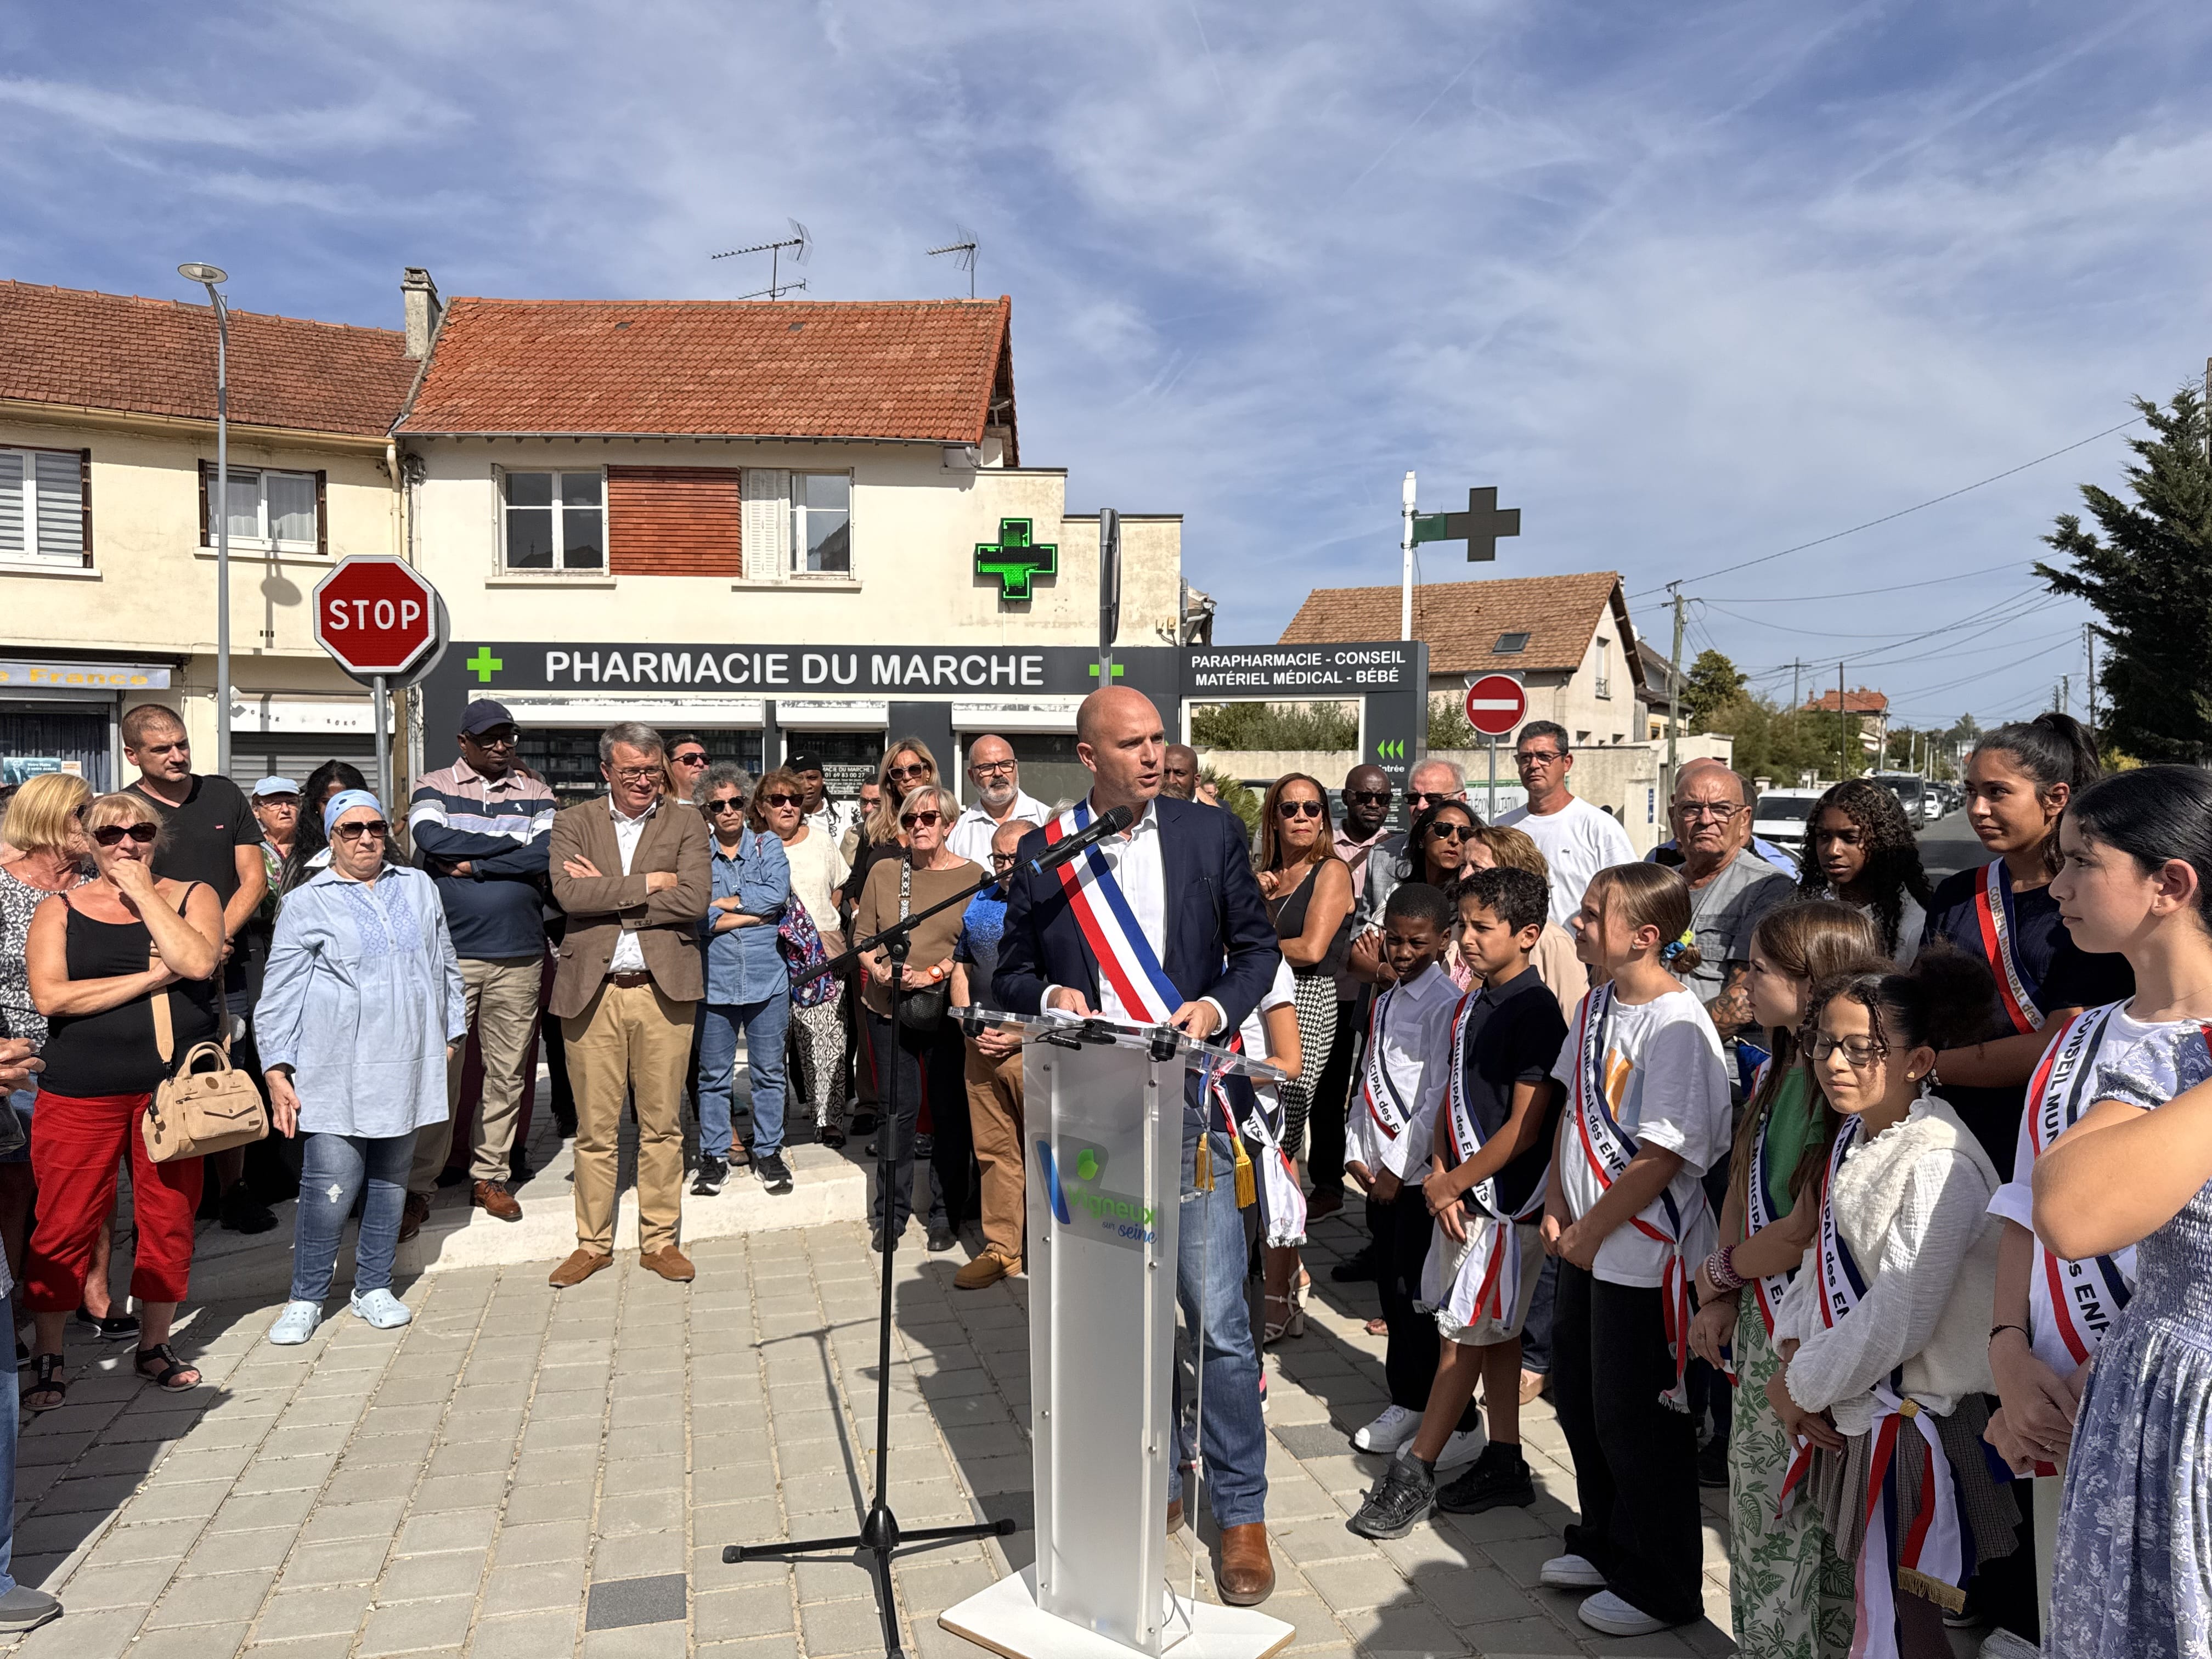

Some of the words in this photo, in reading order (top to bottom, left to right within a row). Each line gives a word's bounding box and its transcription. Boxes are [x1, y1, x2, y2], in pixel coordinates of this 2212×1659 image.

[329, 599, 420, 630] STOP
[30, 668, 149, 685] France
[546, 651, 789, 684] PHARMACIE
[802, 653, 857, 685] DU
[872, 654, 1043, 686] MARCHE
[1192, 653, 1322, 668] PARAPHARMACIE
[1335, 650, 1406, 665] CONSEIL
[1195, 670, 1269, 686] MATÉRIEL
[1273, 669, 1343, 685] MÉDICAL
[1356, 667, 1399, 684] BÉBÉ
[1378, 764, 1404, 772] ntrée
[1989, 886, 2006, 936] CONSEIL
[2000, 936, 2024, 1003] MUNICIPAL
[2022, 1001, 2041, 1025] des
[1588, 988, 1602, 1032] ONSEIL
[2050, 1009, 2102, 1090] CONSEIL
[1452, 1036, 1462, 1112] MUNICIPAL
[1584, 1033, 1594, 1113] MUNICIPAL
[1379, 1097, 1392, 1121] des
[1456, 1115, 1465, 1138] des
[2045, 1092, 2062, 1146] MUN
[1590, 1115, 1602, 1140] des
[1066, 1184, 1156, 1226] Vigneux
[1751, 1147, 1762, 1234] MUNICIPA
[1102, 1220, 1115, 1231] sur
[1118, 1223, 1157, 1244] seine
[1825, 1250, 1837, 1288] des
